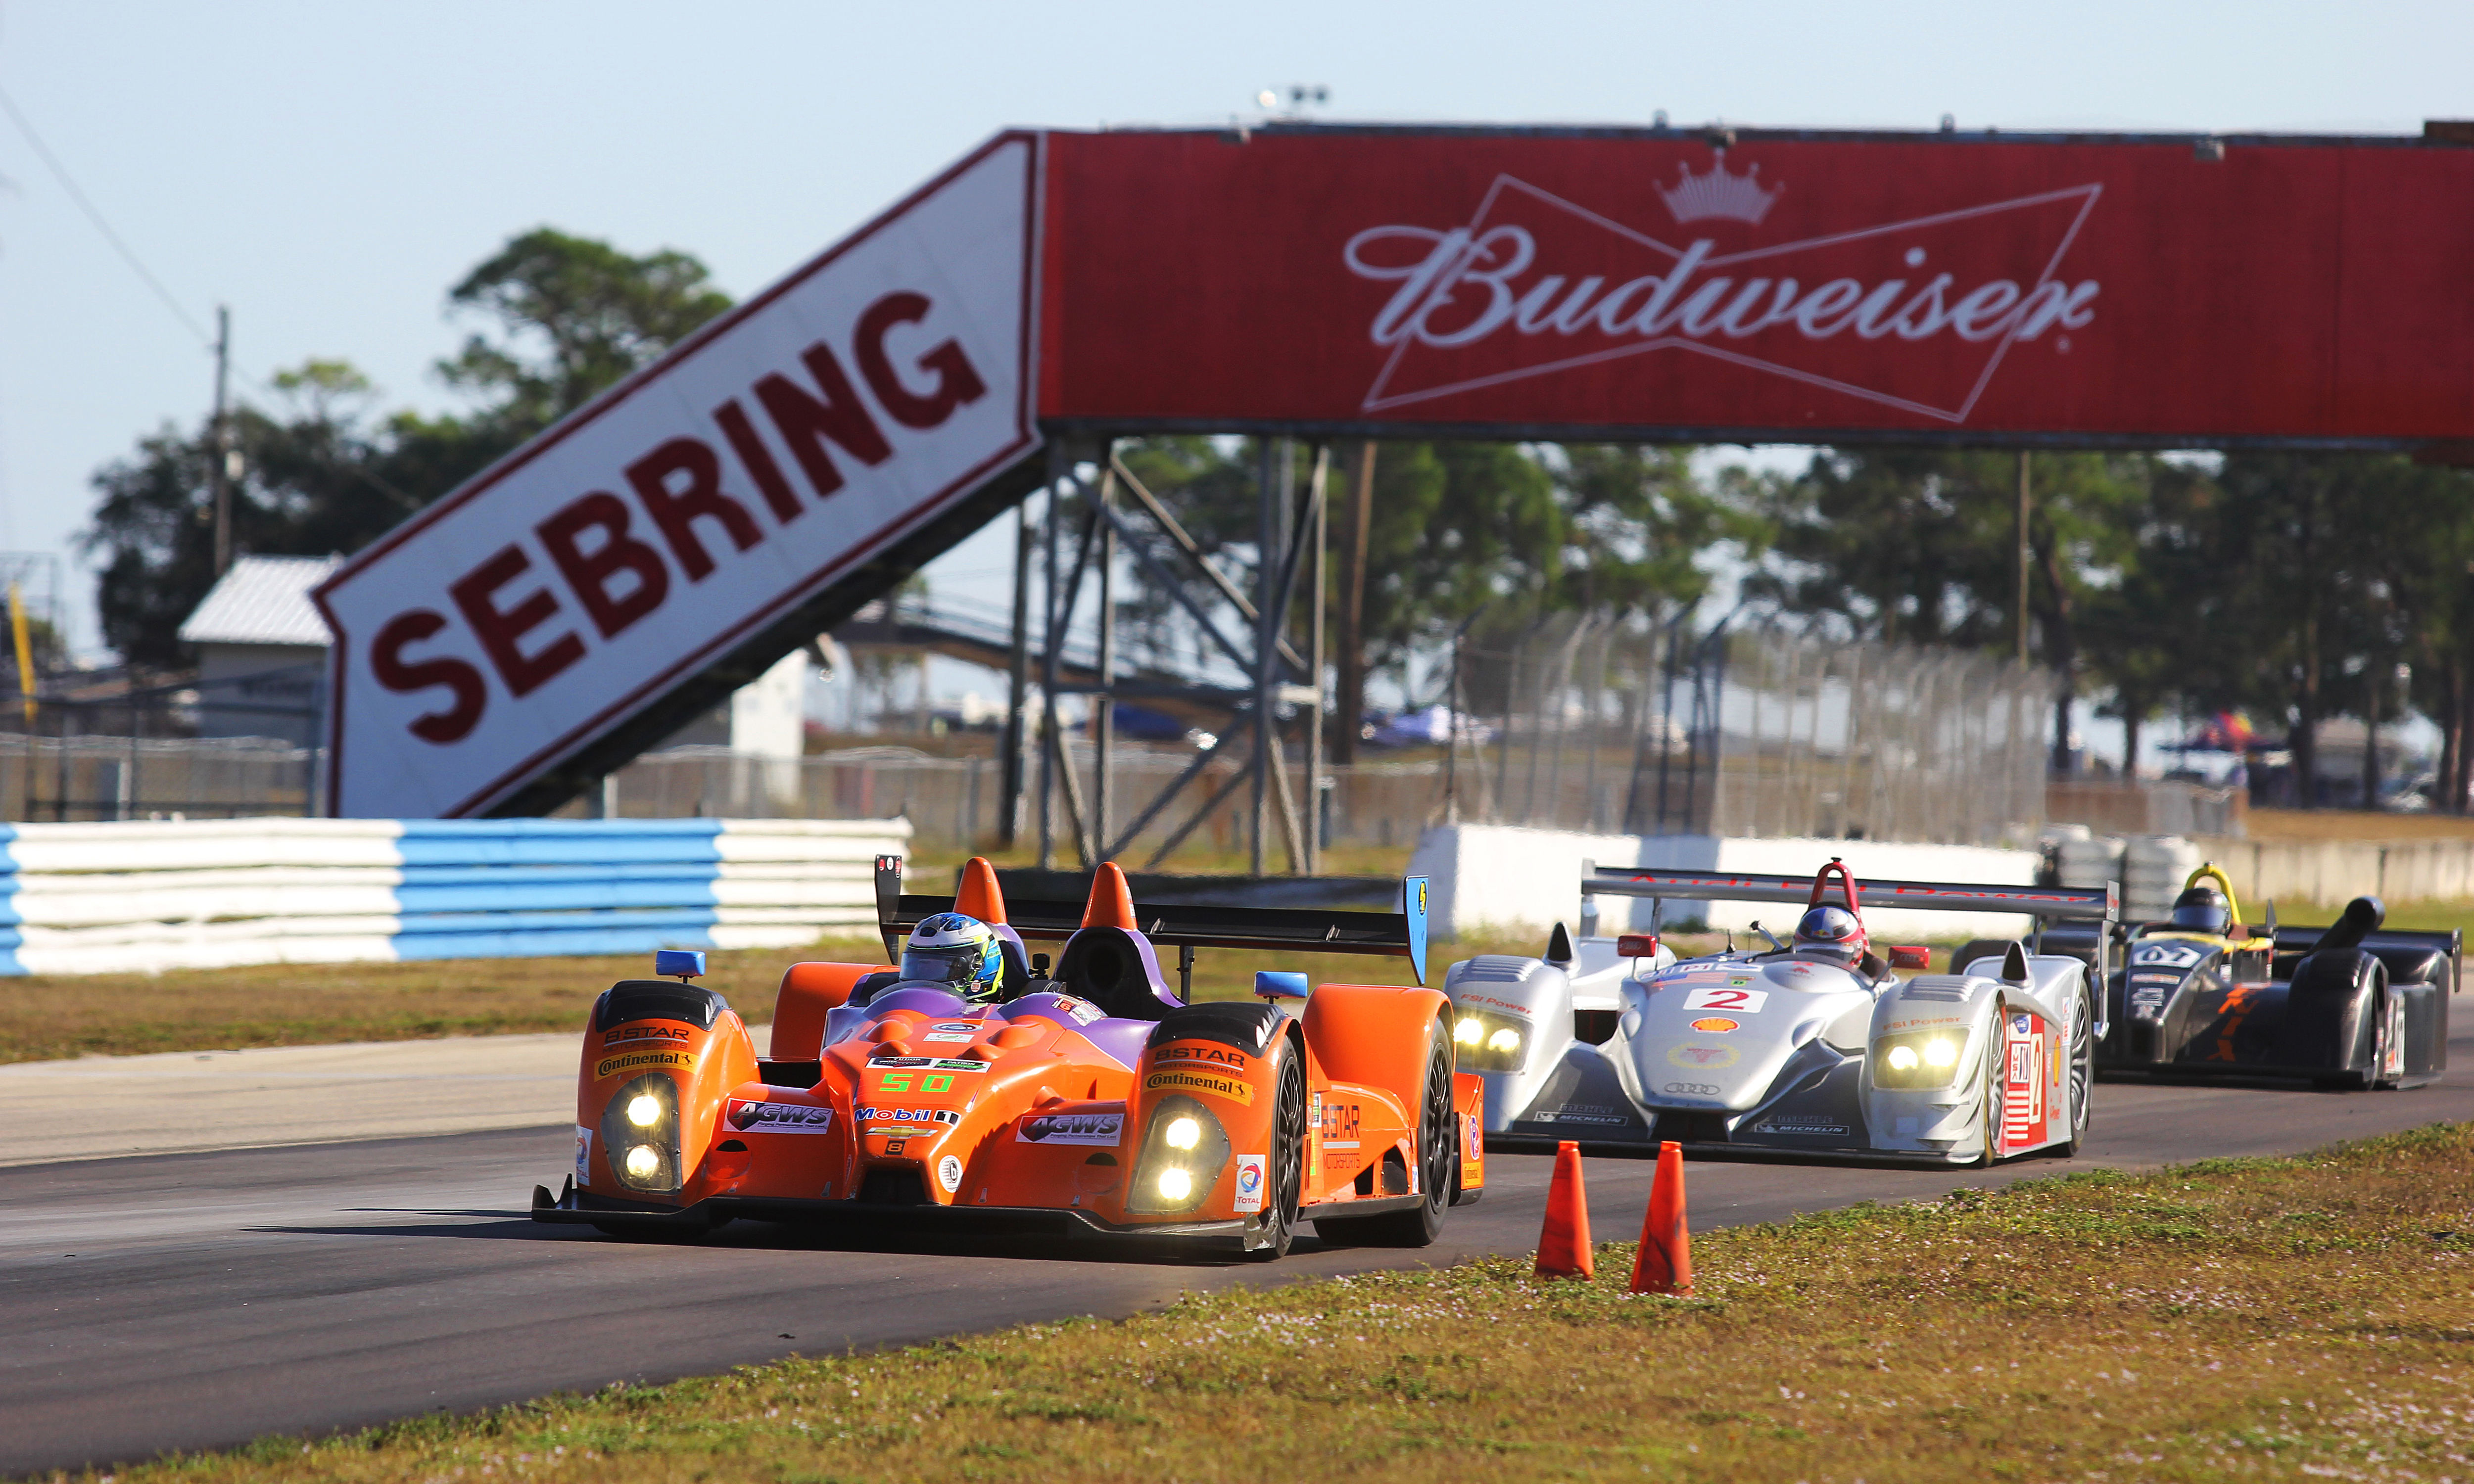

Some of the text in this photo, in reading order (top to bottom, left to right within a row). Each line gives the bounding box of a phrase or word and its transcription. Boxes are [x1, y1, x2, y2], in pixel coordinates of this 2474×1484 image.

[1344, 224, 2100, 347] Budweiser
[369, 289, 987, 746] SEBRING
[1460, 994, 1531, 1014] FSI Power
[1700, 990, 1750, 1010] 2
[1883, 1017, 1961, 1031] FSI Power
[603, 1041, 687, 1054] MOTORSPORTS
[598, 1053, 679, 1076] Continental
[1153, 1063, 1242, 1077] MOTORSPORTS
[879, 1073, 954, 1092] 50
[1147, 1073, 1233, 1093] Continental
[732, 1102, 830, 1124] AGWS
[853, 1108, 931, 1124] Mobil
[1559, 1114, 1621, 1123] MICHELIN
[1026, 1116, 1121, 1134] AGWS
[887, 1142, 904, 1152] 8
